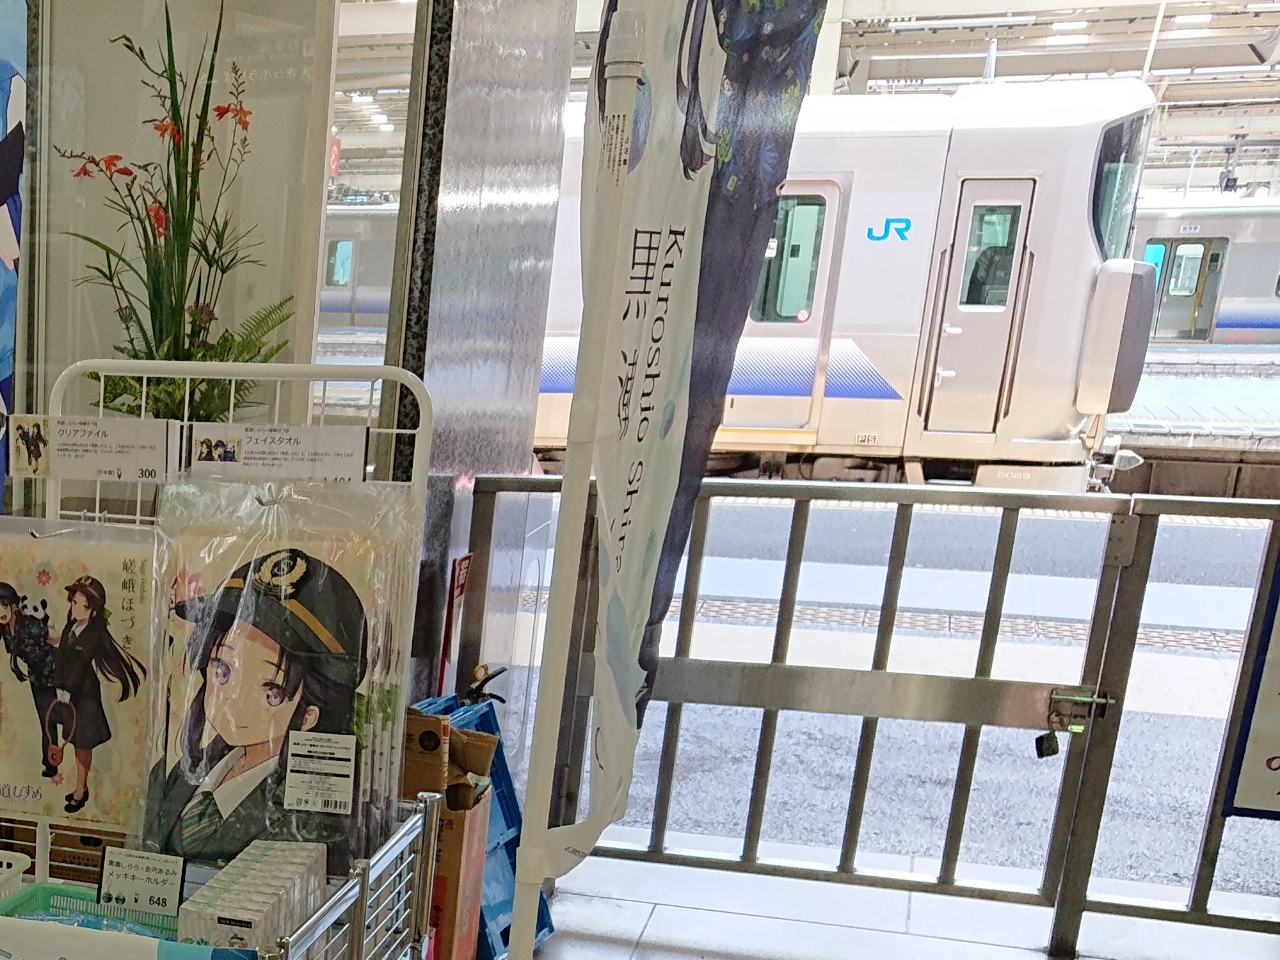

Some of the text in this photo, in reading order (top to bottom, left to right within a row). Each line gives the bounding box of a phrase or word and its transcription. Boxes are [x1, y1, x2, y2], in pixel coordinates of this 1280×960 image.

[867, 218, 912, 241] JR
[636, 225, 687, 442] Kuroshio
[58, 428, 109, 439] クリアファイル
[245, 436, 302, 446] フェイスタオル
[138, 468, 157, 479] 300
[148, 895, 167, 908] 648
